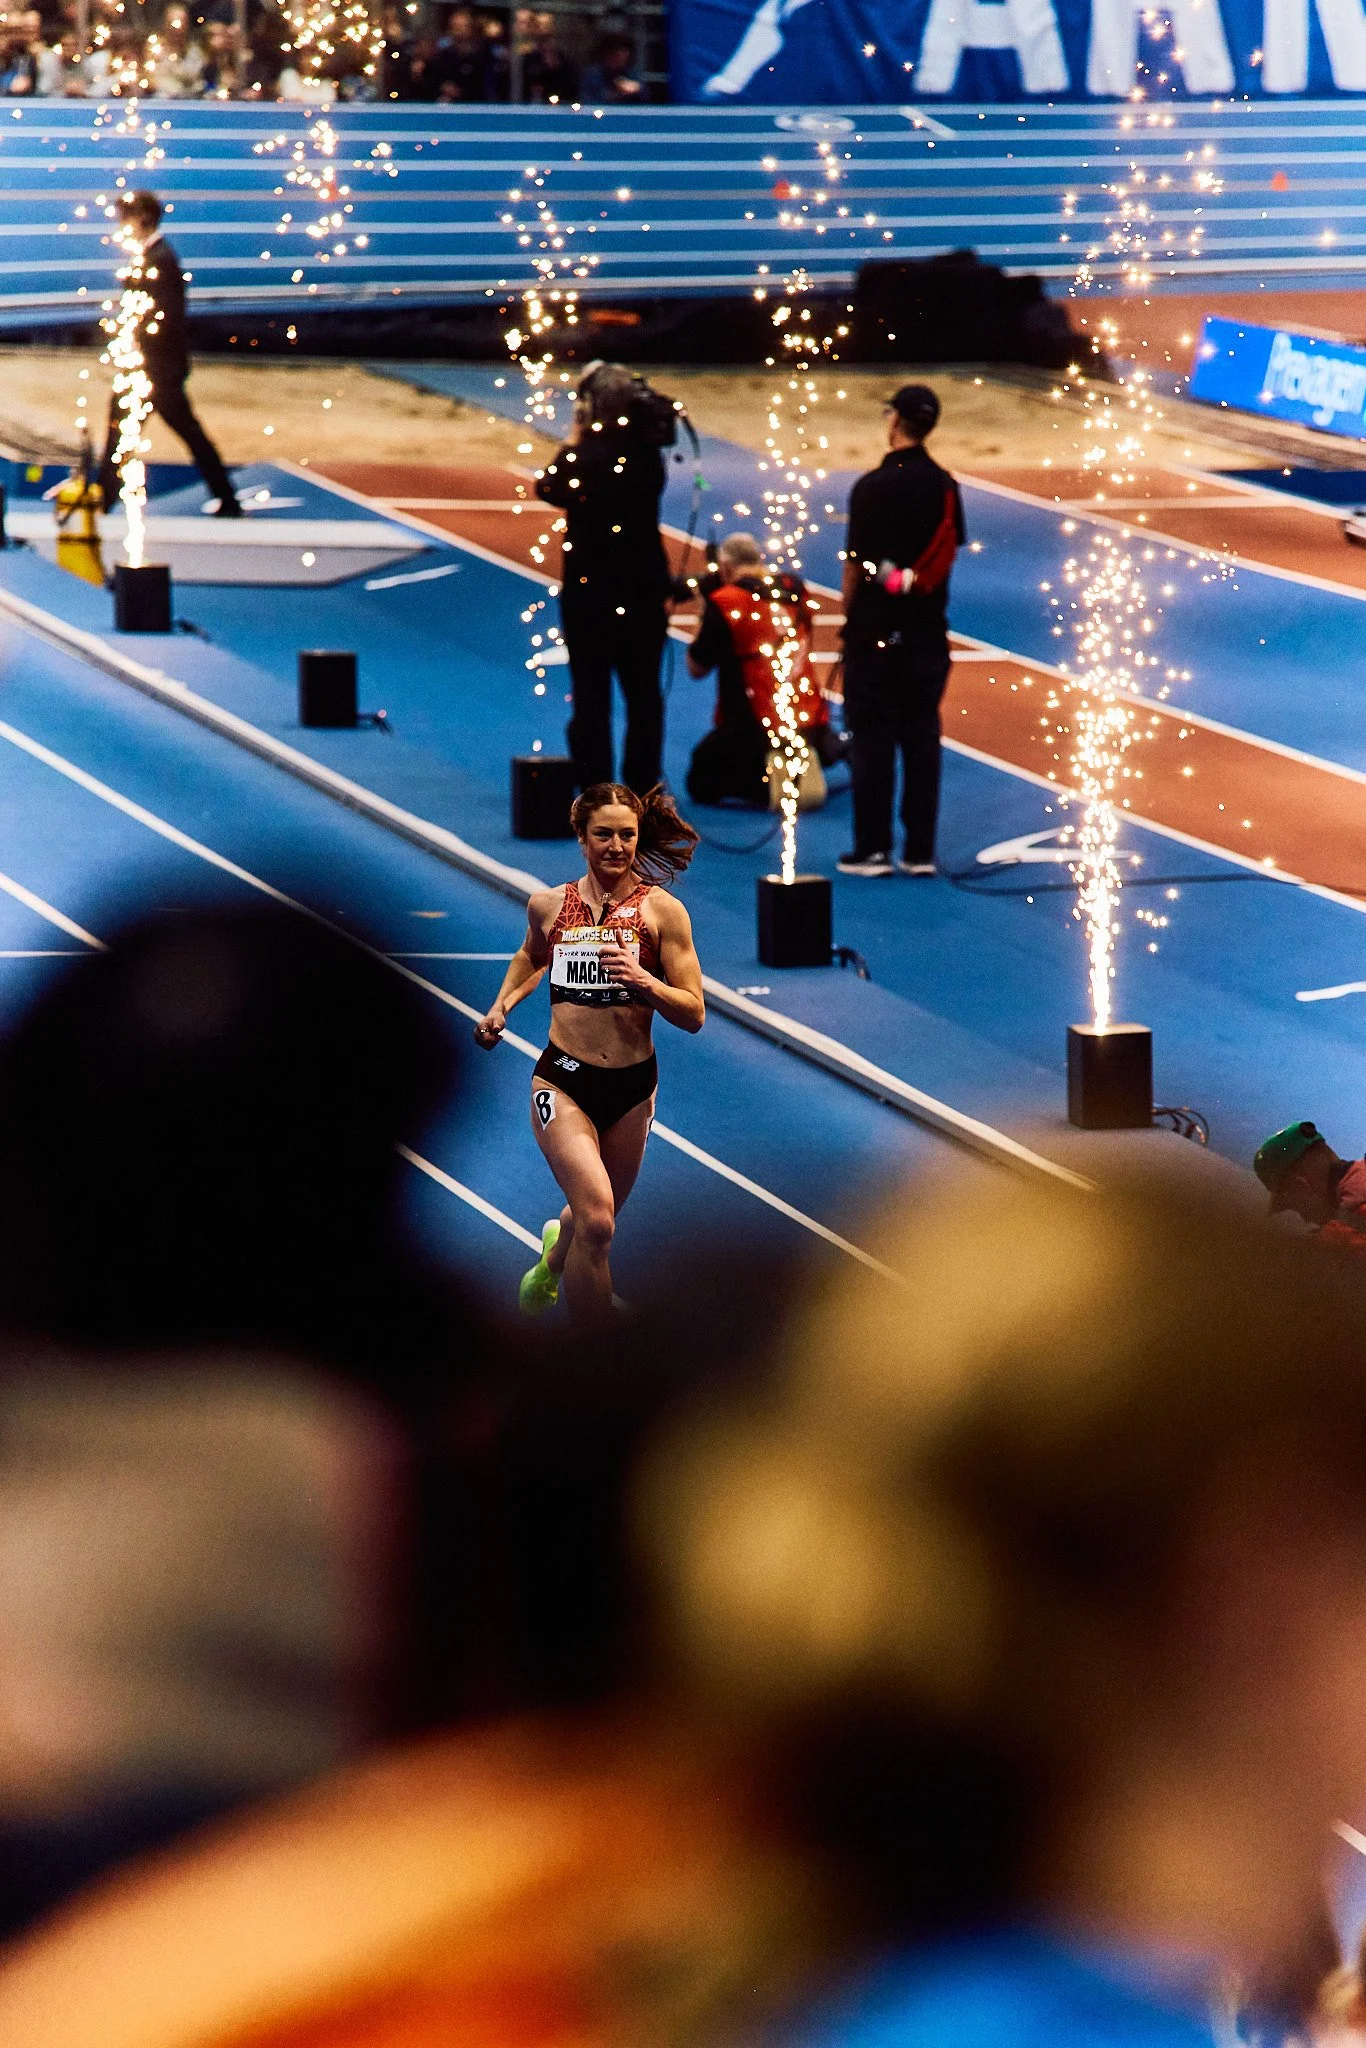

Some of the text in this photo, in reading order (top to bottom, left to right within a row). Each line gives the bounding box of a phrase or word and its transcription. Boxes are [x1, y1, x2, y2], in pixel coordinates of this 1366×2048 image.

[561, 930, 600, 942] MILLROSE
[566, 960, 616, 985] MACK
[535, 1091, 552, 1125] 8
